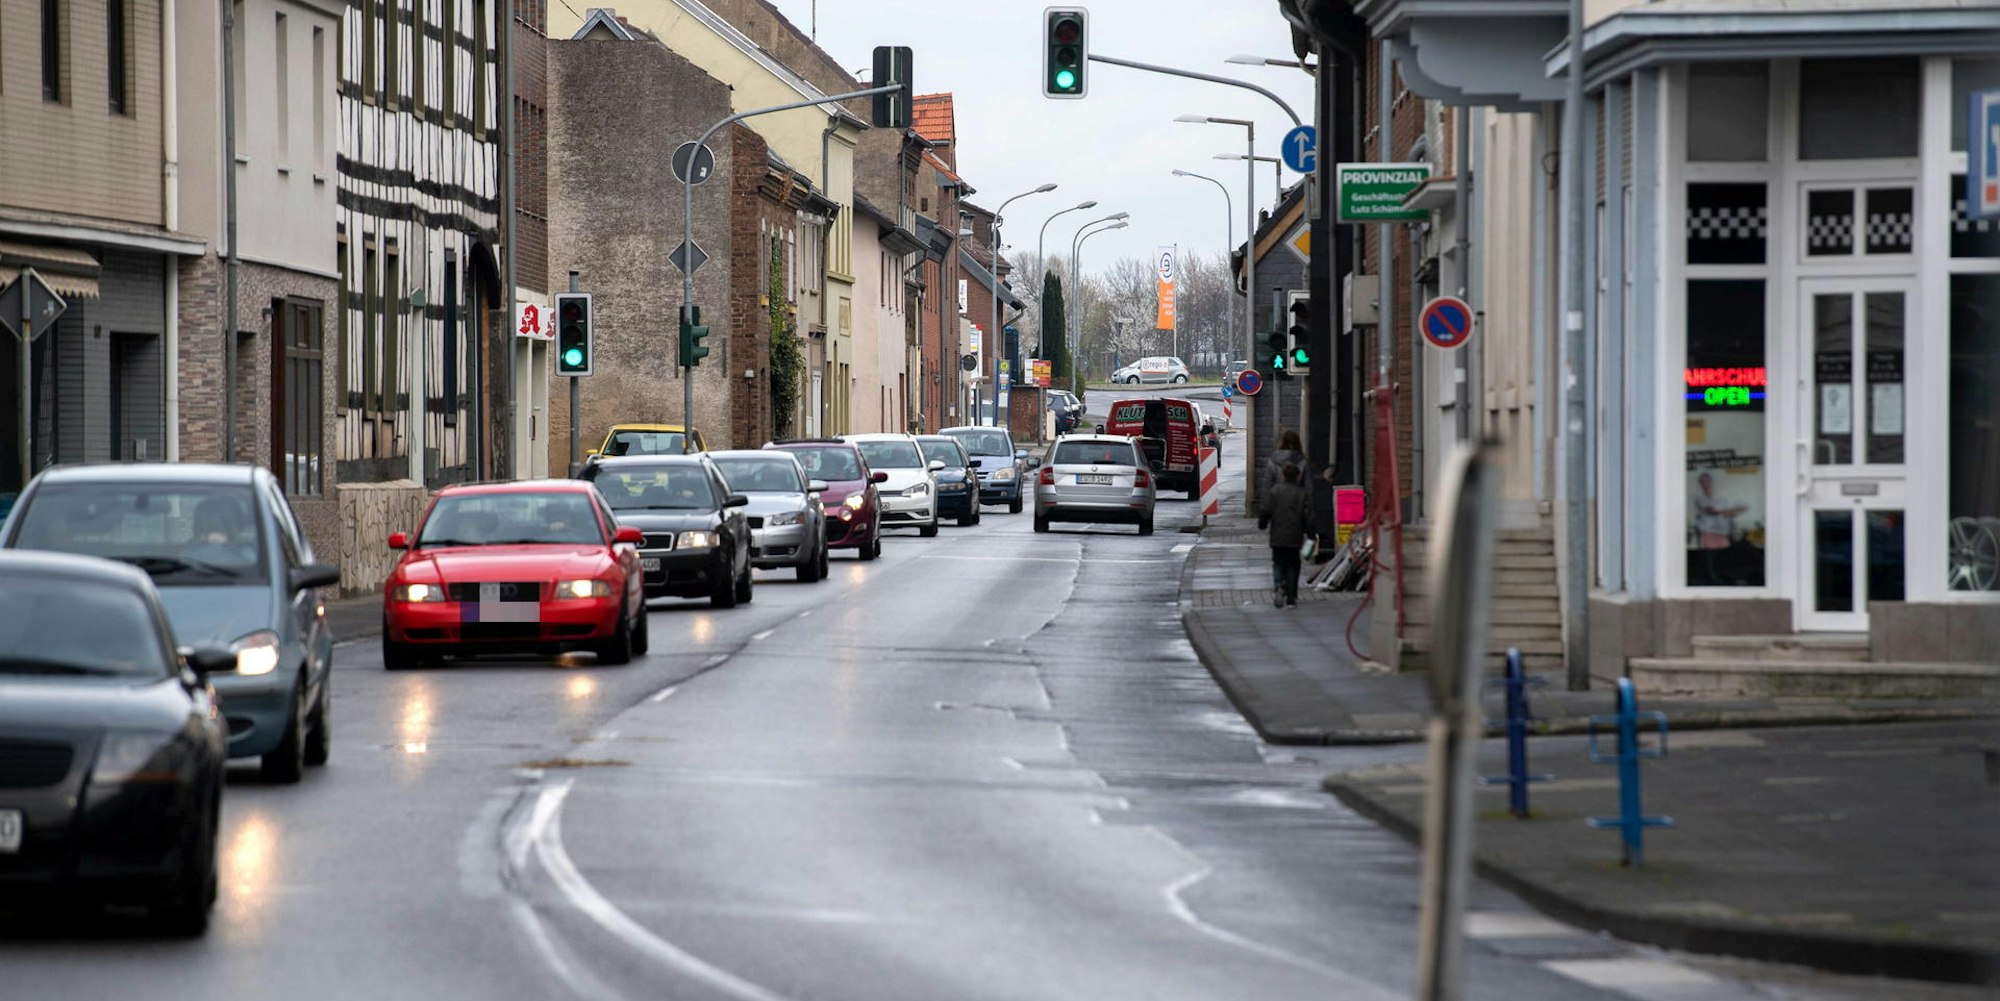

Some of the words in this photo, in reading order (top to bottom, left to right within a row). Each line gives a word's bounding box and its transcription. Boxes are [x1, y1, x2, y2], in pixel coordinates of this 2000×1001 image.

[1343, 171, 1422, 184] PROVINZIAL
[1351, 205, 1370, 213] Lutz
[1704, 387, 1749, 405] OPEN
